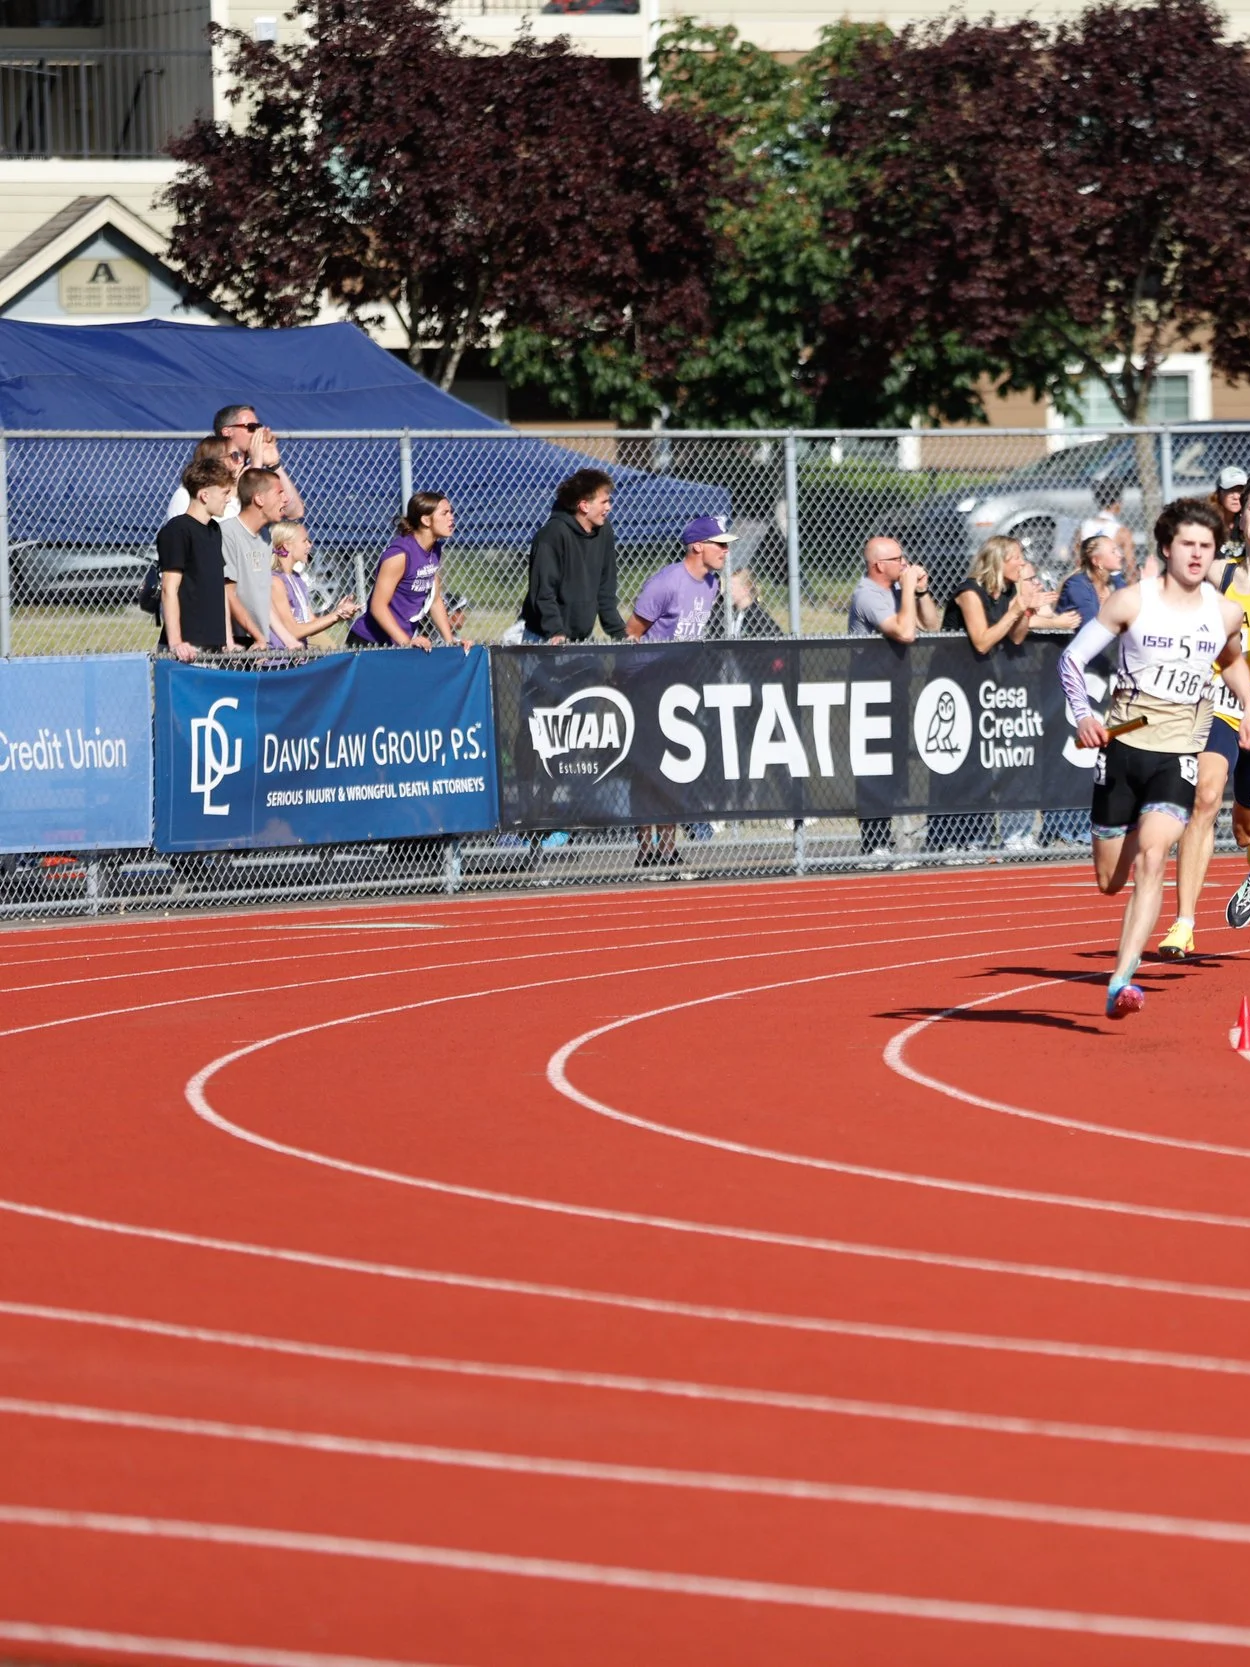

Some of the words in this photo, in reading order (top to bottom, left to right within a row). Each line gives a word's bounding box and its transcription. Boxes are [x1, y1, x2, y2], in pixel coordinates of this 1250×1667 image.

[87, 263, 119, 284] A
[1180, 635, 1191, 659] 5
[979, 680, 1028, 709] Gesa
[1153, 664, 1201, 696] 1136
[533, 707, 621, 752] WIAA
[658, 680, 894, 784] STATE
[979, 709, 1044, 739] Credit
[0, 728, 64, 772] Credit
[65, 726, 127, 769] Union
[263, 733, 320, 773] DAVIS
[325, 729, 367, 769] LAW
[372, 725, 446, 766] GROUP,
[980, 739, 1035, 769] Union
[1186, 758, 1196, 781] 5
[266, 790, 303, 807] SERIOUS
[305, 787, 336, 804] INJURY
[338, 786, 346, 802] &
[346, 782, 397, 801] WRONGFUL
[398, 780, 430, 798] DEATH
[432, 776, 485, 796] ATTORNEYS
